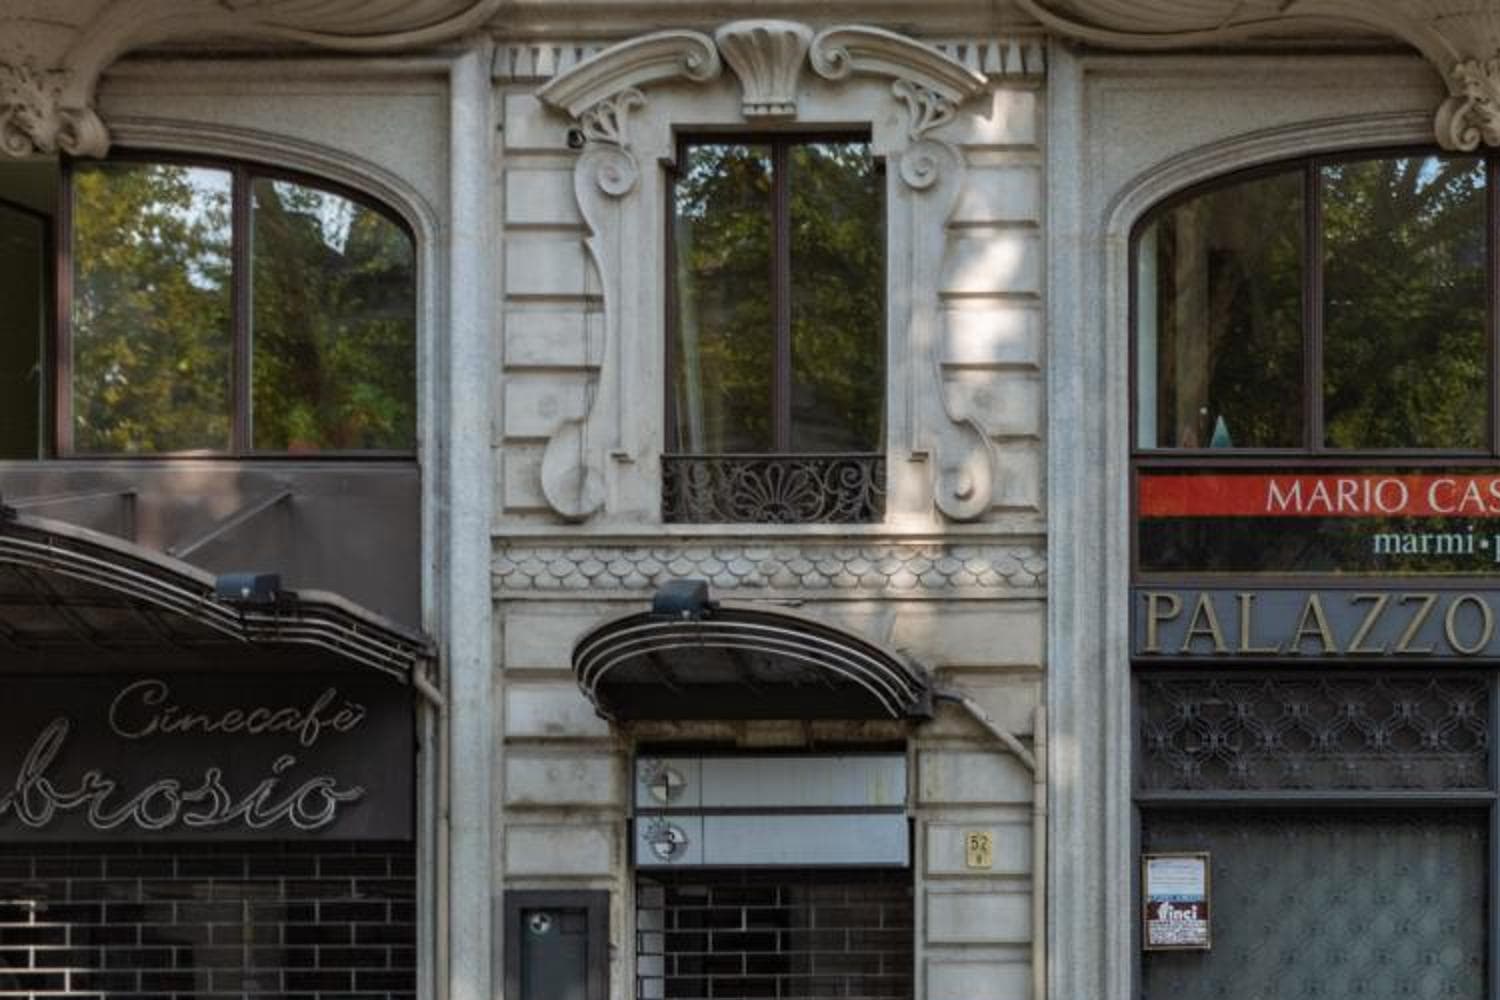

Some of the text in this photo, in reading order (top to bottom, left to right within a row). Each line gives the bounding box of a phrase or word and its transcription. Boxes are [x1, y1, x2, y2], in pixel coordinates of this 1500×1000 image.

[1265, 479, 1409, 513] MARIO
[1142, 592, 1496, 656] PALAZZO
[0, 716, 367, 829] brosio
